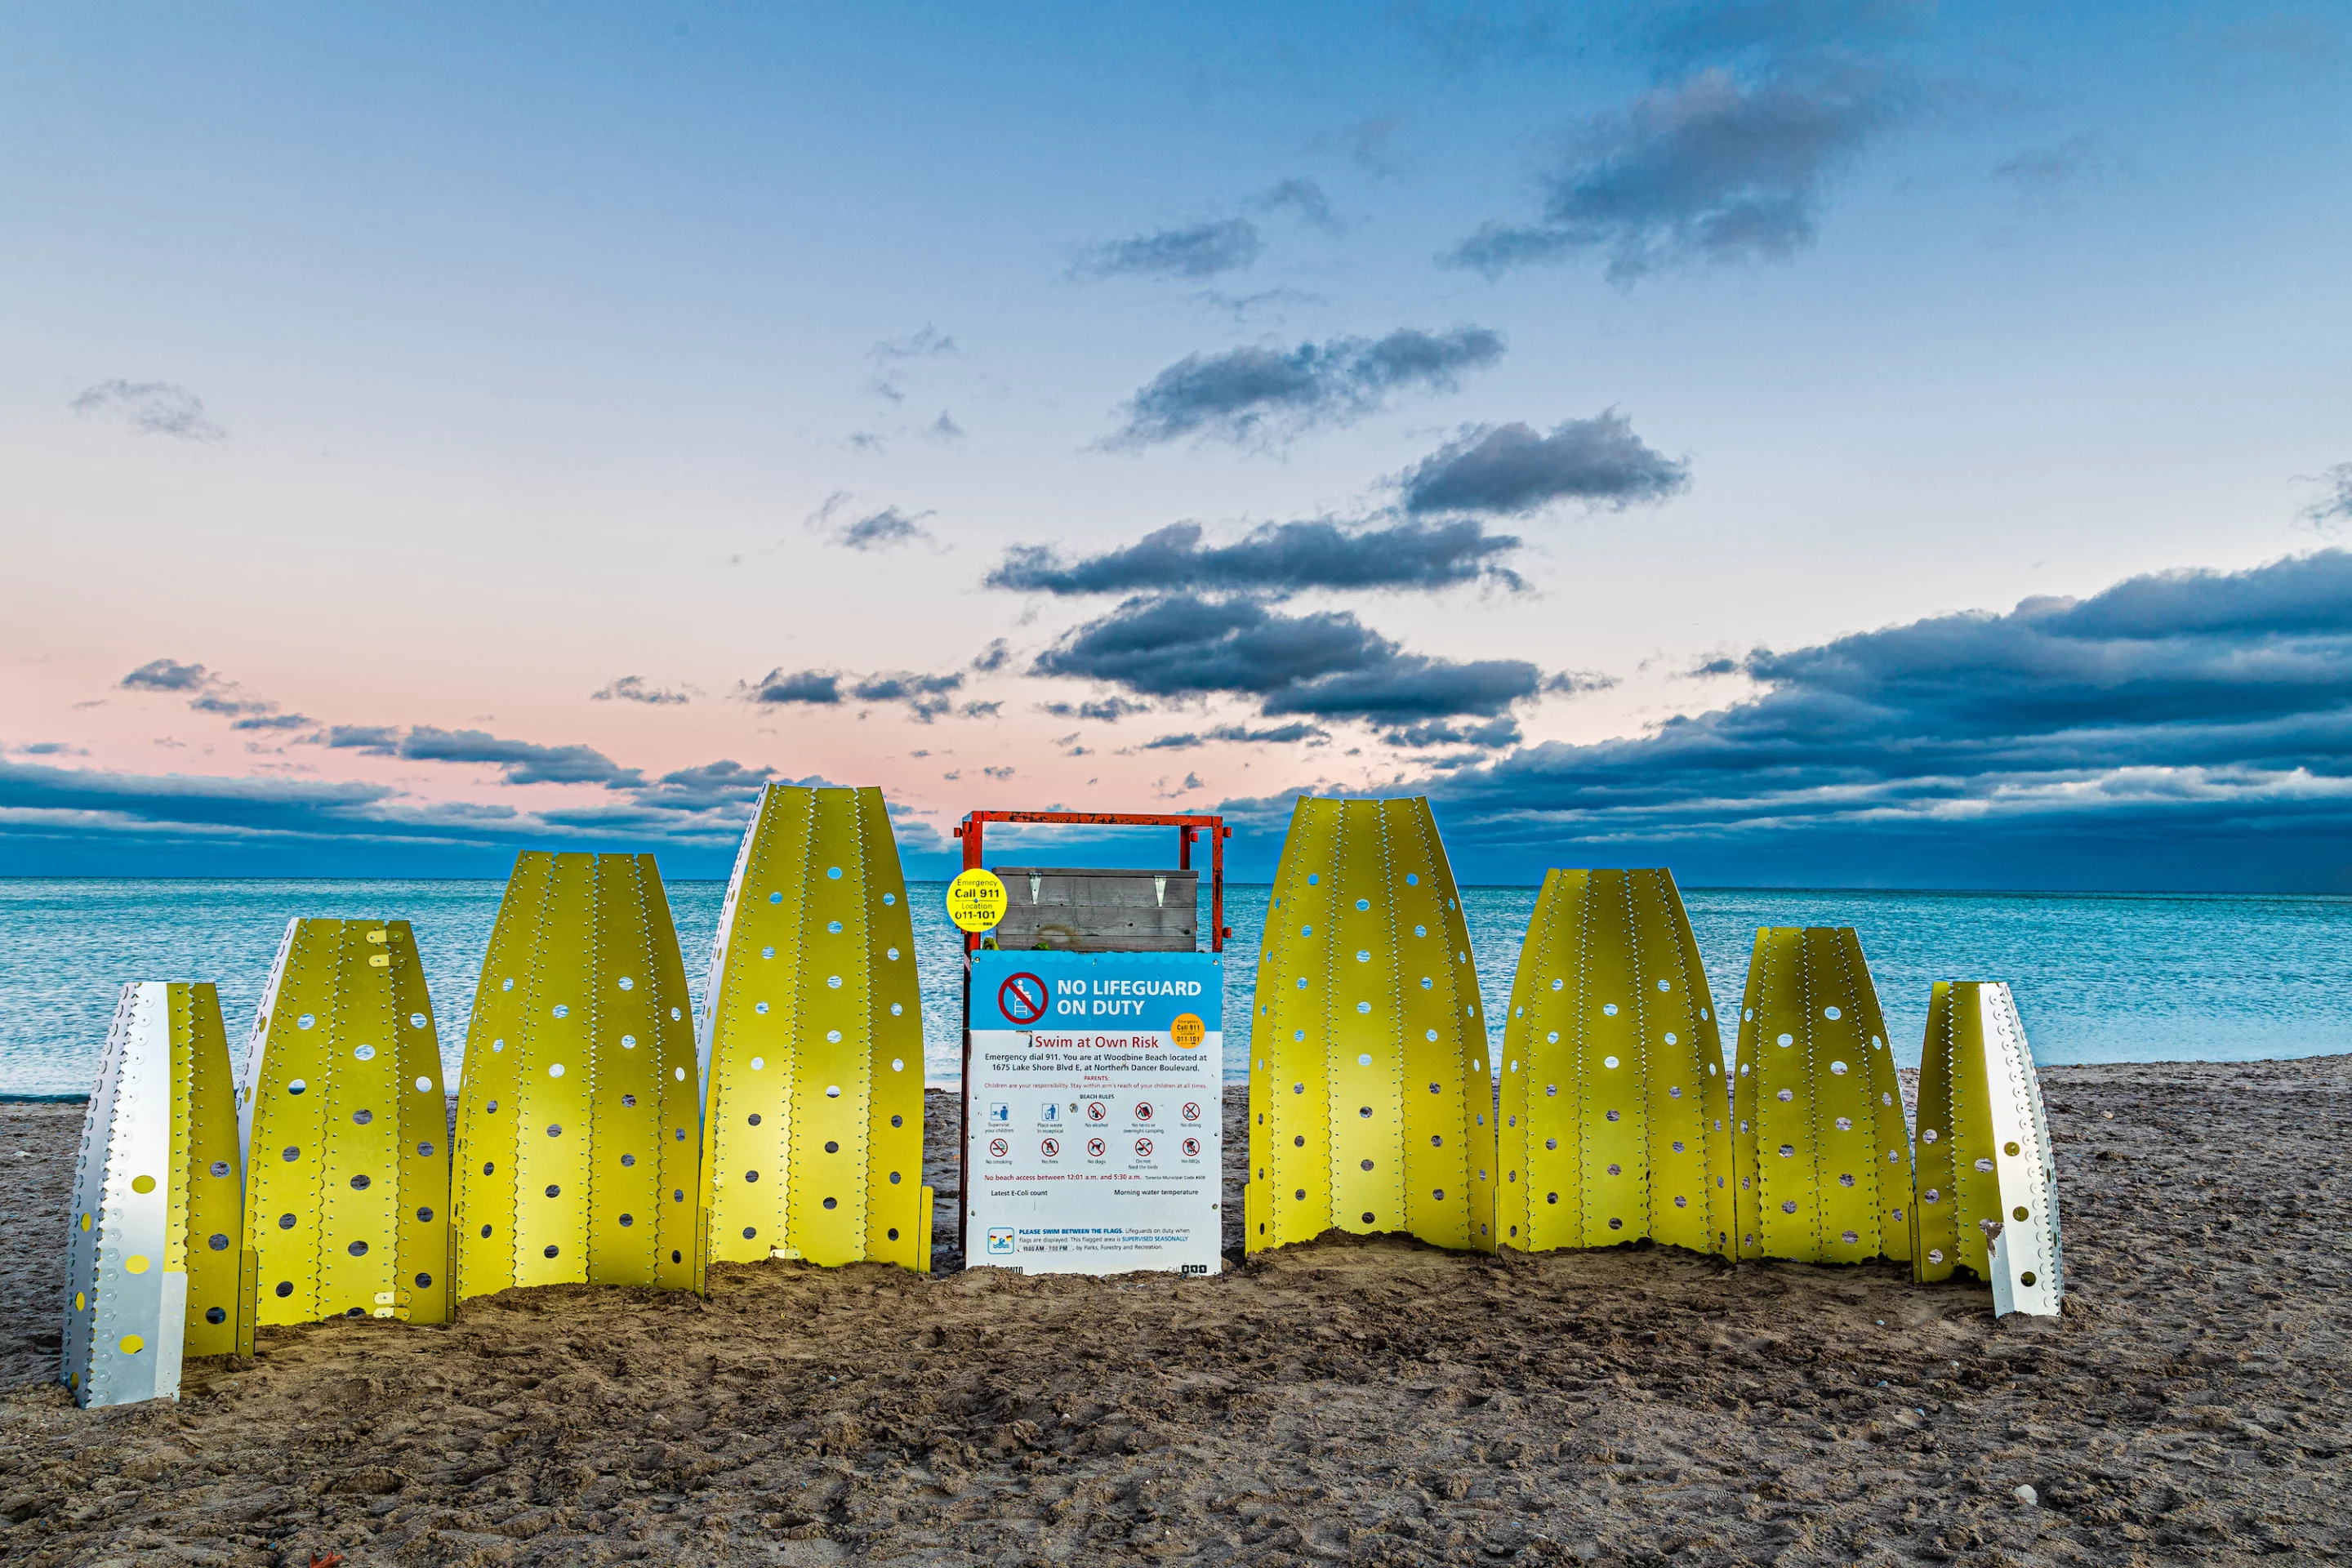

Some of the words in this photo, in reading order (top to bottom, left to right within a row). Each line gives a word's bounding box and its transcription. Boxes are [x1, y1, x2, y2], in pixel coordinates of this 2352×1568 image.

[955, 889, 975, 898] Call
[980, 889, 999, 897] 911
[1058, 980, 1086, 996] NO
[1094, 980, 1202, 996] LIFEGUARD
[1057, 1000, 1086, 1015] ON
[1094, 1000, 1145, 1015] DUTY
[1035, 1036, 1072, 1047] Swim
[1078, 1037, 1091, 1047] at
[1095, 1036, 1127, 1048] Own
[1132, 1036, 1158, 1048] Risk
[985, 1054, 1027, 1062] Emergency
